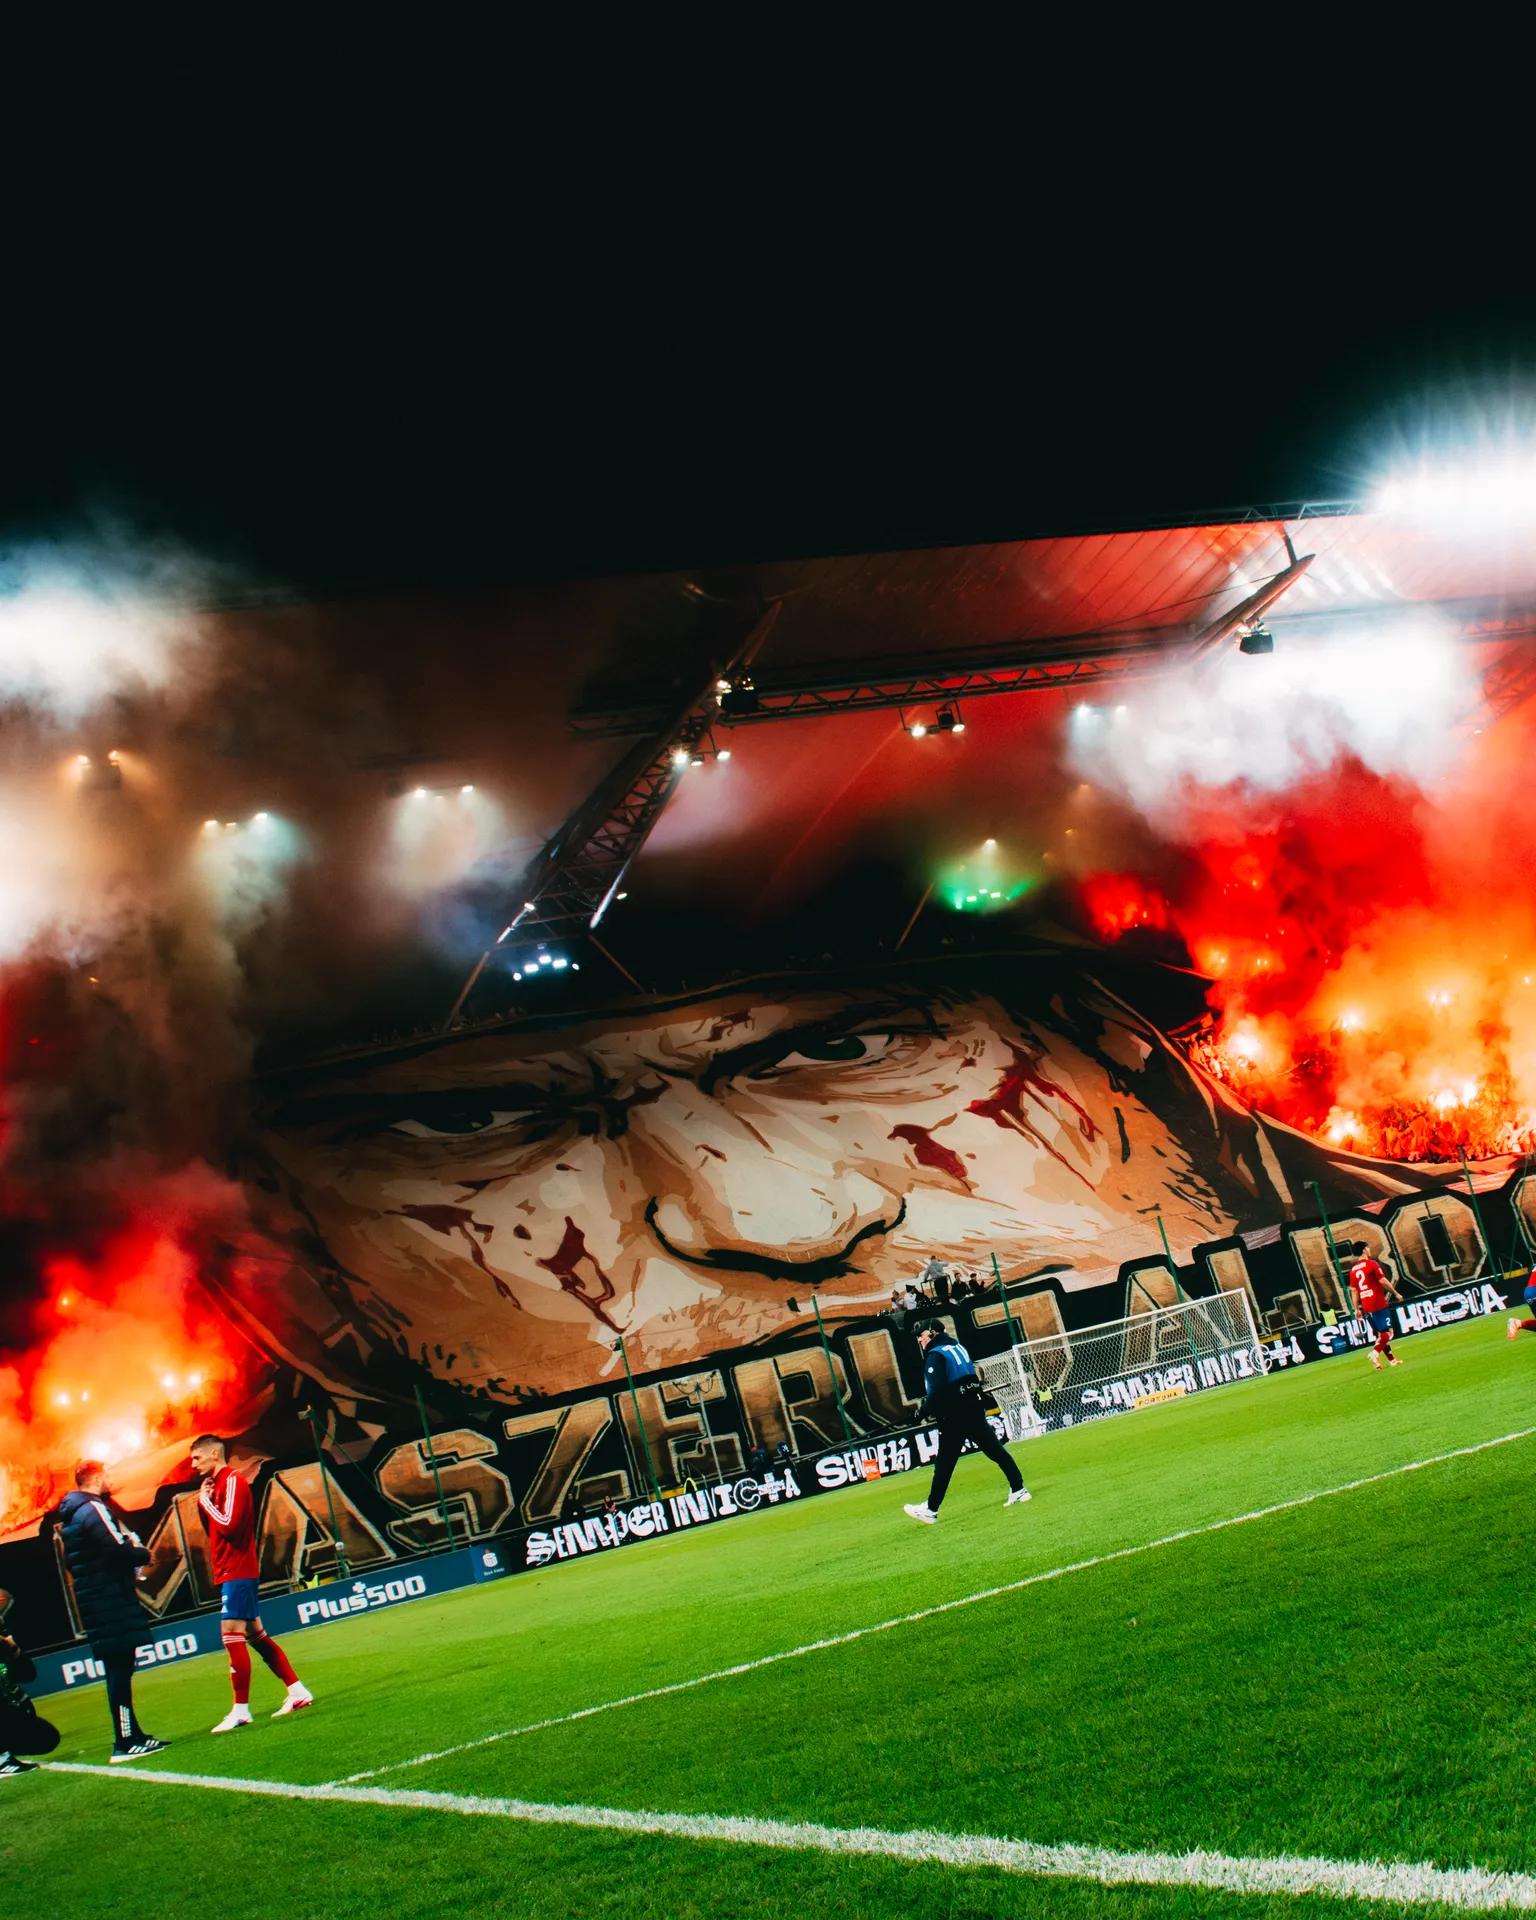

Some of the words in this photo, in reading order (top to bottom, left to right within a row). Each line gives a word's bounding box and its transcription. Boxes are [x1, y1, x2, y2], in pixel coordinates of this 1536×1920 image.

[1355, 1269, 1368, 1291] 2
[1138, 1391, 1178, 1406] FORTUNA
[526, 1500, 668, 1567] SEMPER
[297, 1575, 426, 1624] Plus500
[62, 1633, 198, 1685] Plu500
